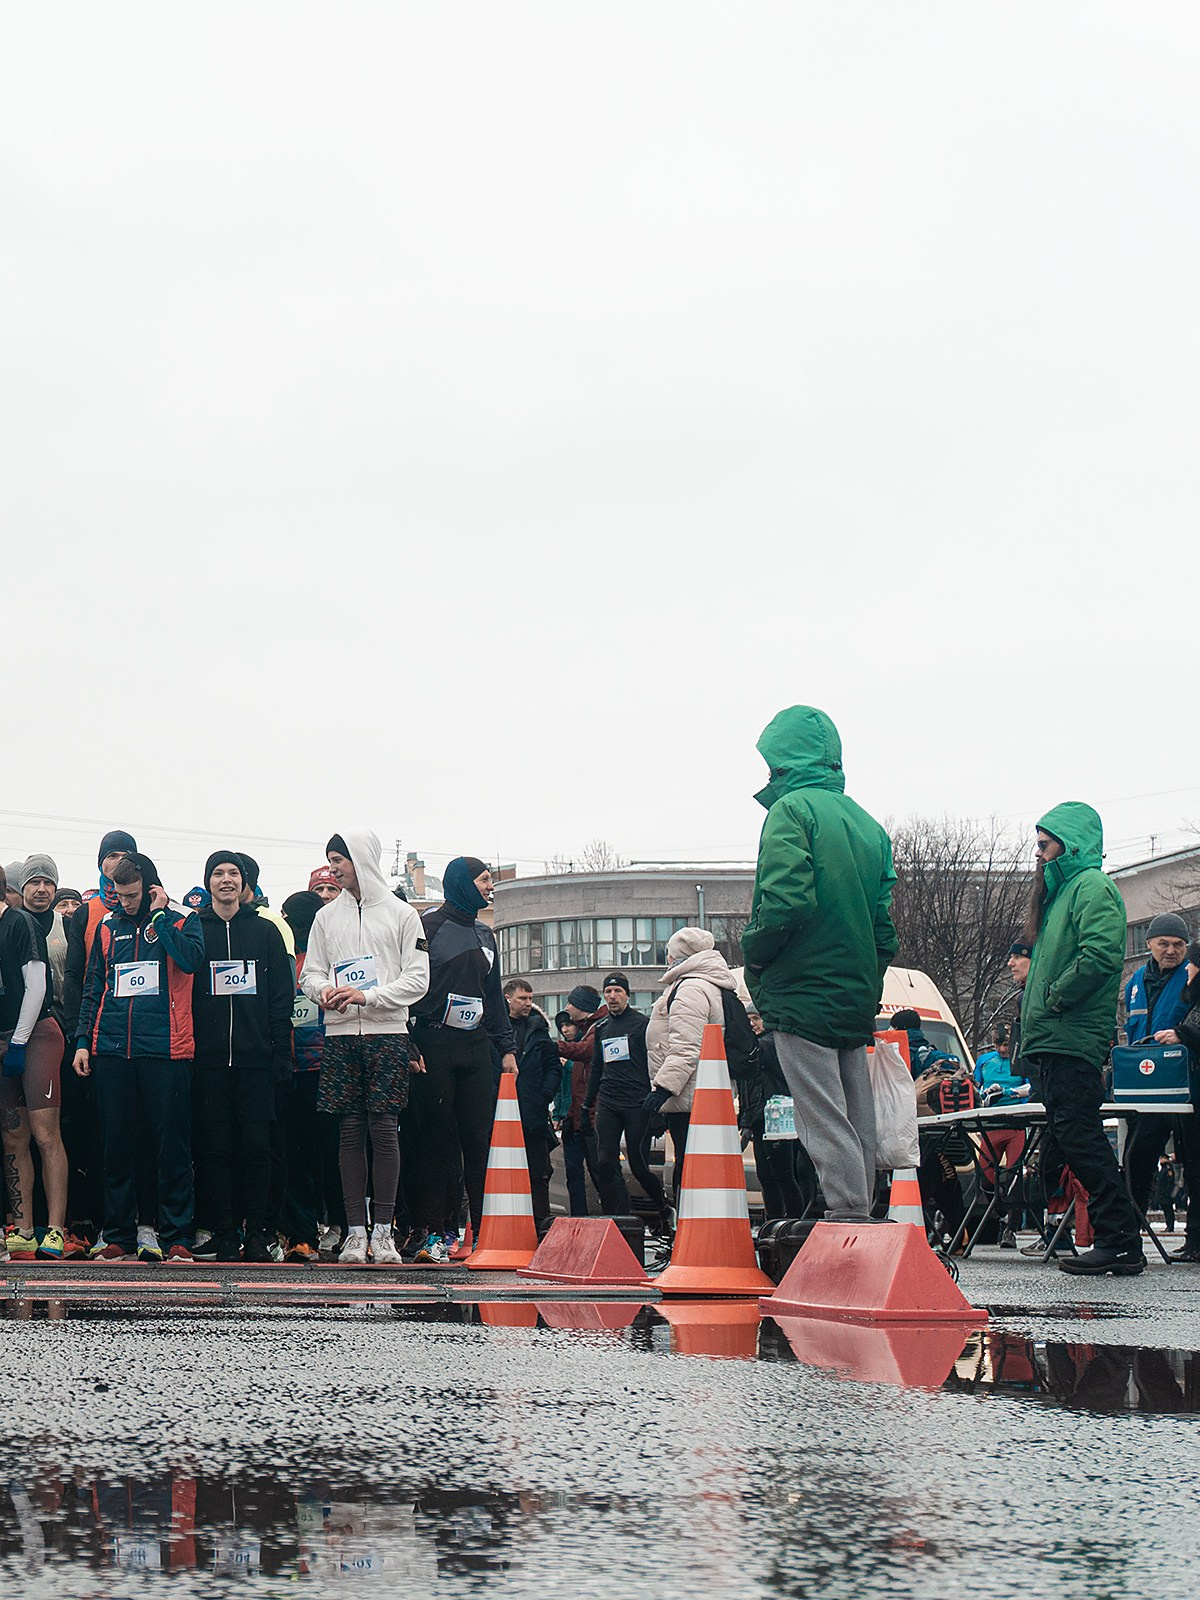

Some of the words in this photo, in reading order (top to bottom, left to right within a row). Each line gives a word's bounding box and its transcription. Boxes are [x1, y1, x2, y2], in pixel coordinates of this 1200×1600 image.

[130, 976, 145, 986] 60
[224, 975, 247, 985] 204
[345, 970, 366, 982] 102
[460, 1010, 477, 1020] 197
[610, 1047, 620, 1055] 50
